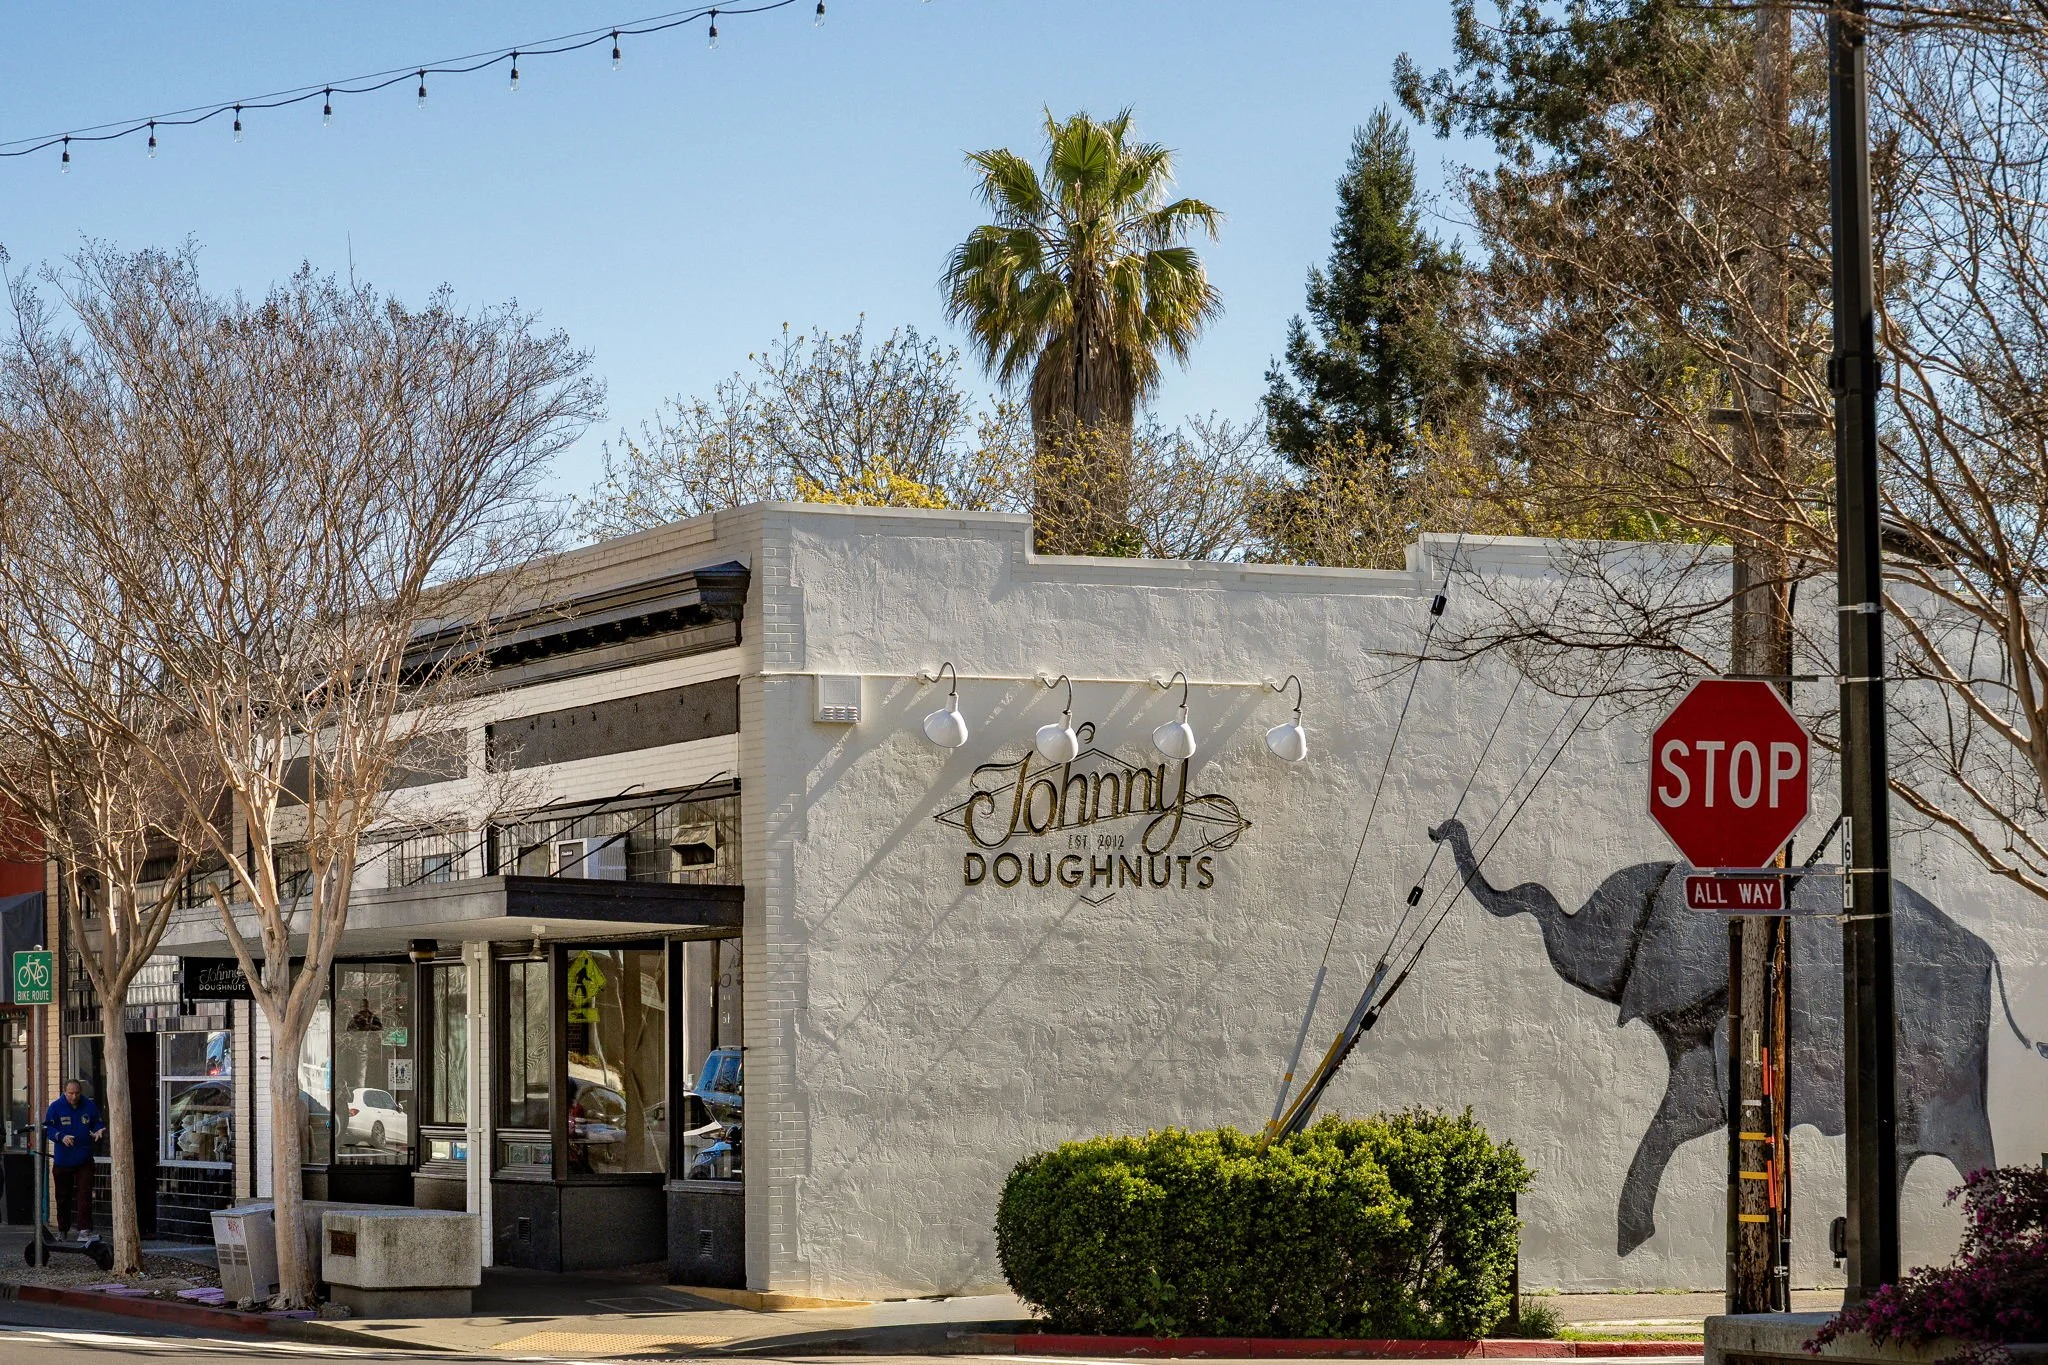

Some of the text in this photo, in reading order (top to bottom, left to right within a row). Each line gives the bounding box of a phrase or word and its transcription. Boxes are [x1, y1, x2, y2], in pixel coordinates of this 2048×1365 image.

[1658, 739, 1801, 808] STOP
[964, 721, 1241, 857] Johnny
[1097, 834, 1125, 850] 2012
[964, 852, 1214, 890] DOUGHNUTS
[1694, 883, 1774, 904] ALL WAY
[17, 990, 49, 1001] BIKE ROUTE
